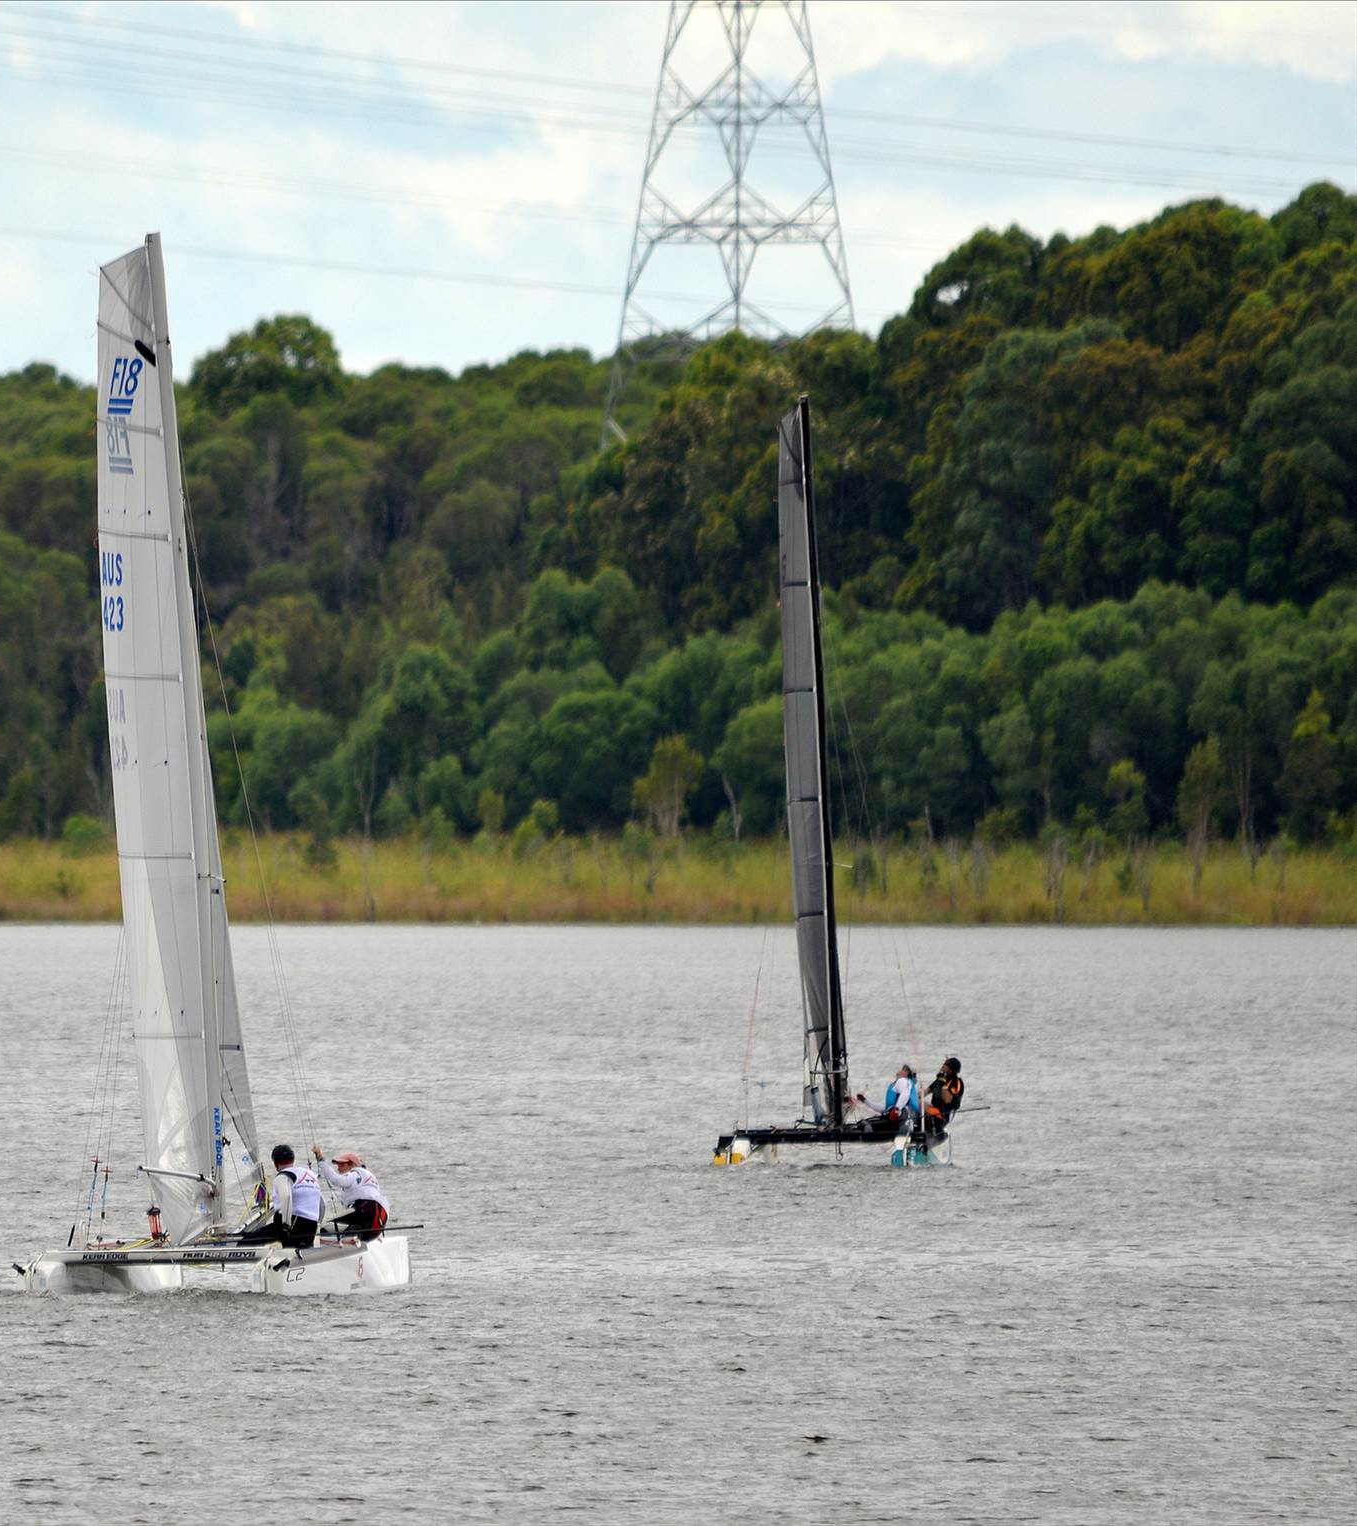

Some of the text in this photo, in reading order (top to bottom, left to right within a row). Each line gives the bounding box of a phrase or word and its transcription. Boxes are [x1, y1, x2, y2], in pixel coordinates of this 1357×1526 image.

[109, 357, 143, 397] F18
[102, 552, 123, 587] AUS
[103, 596, 125, 632] 423
